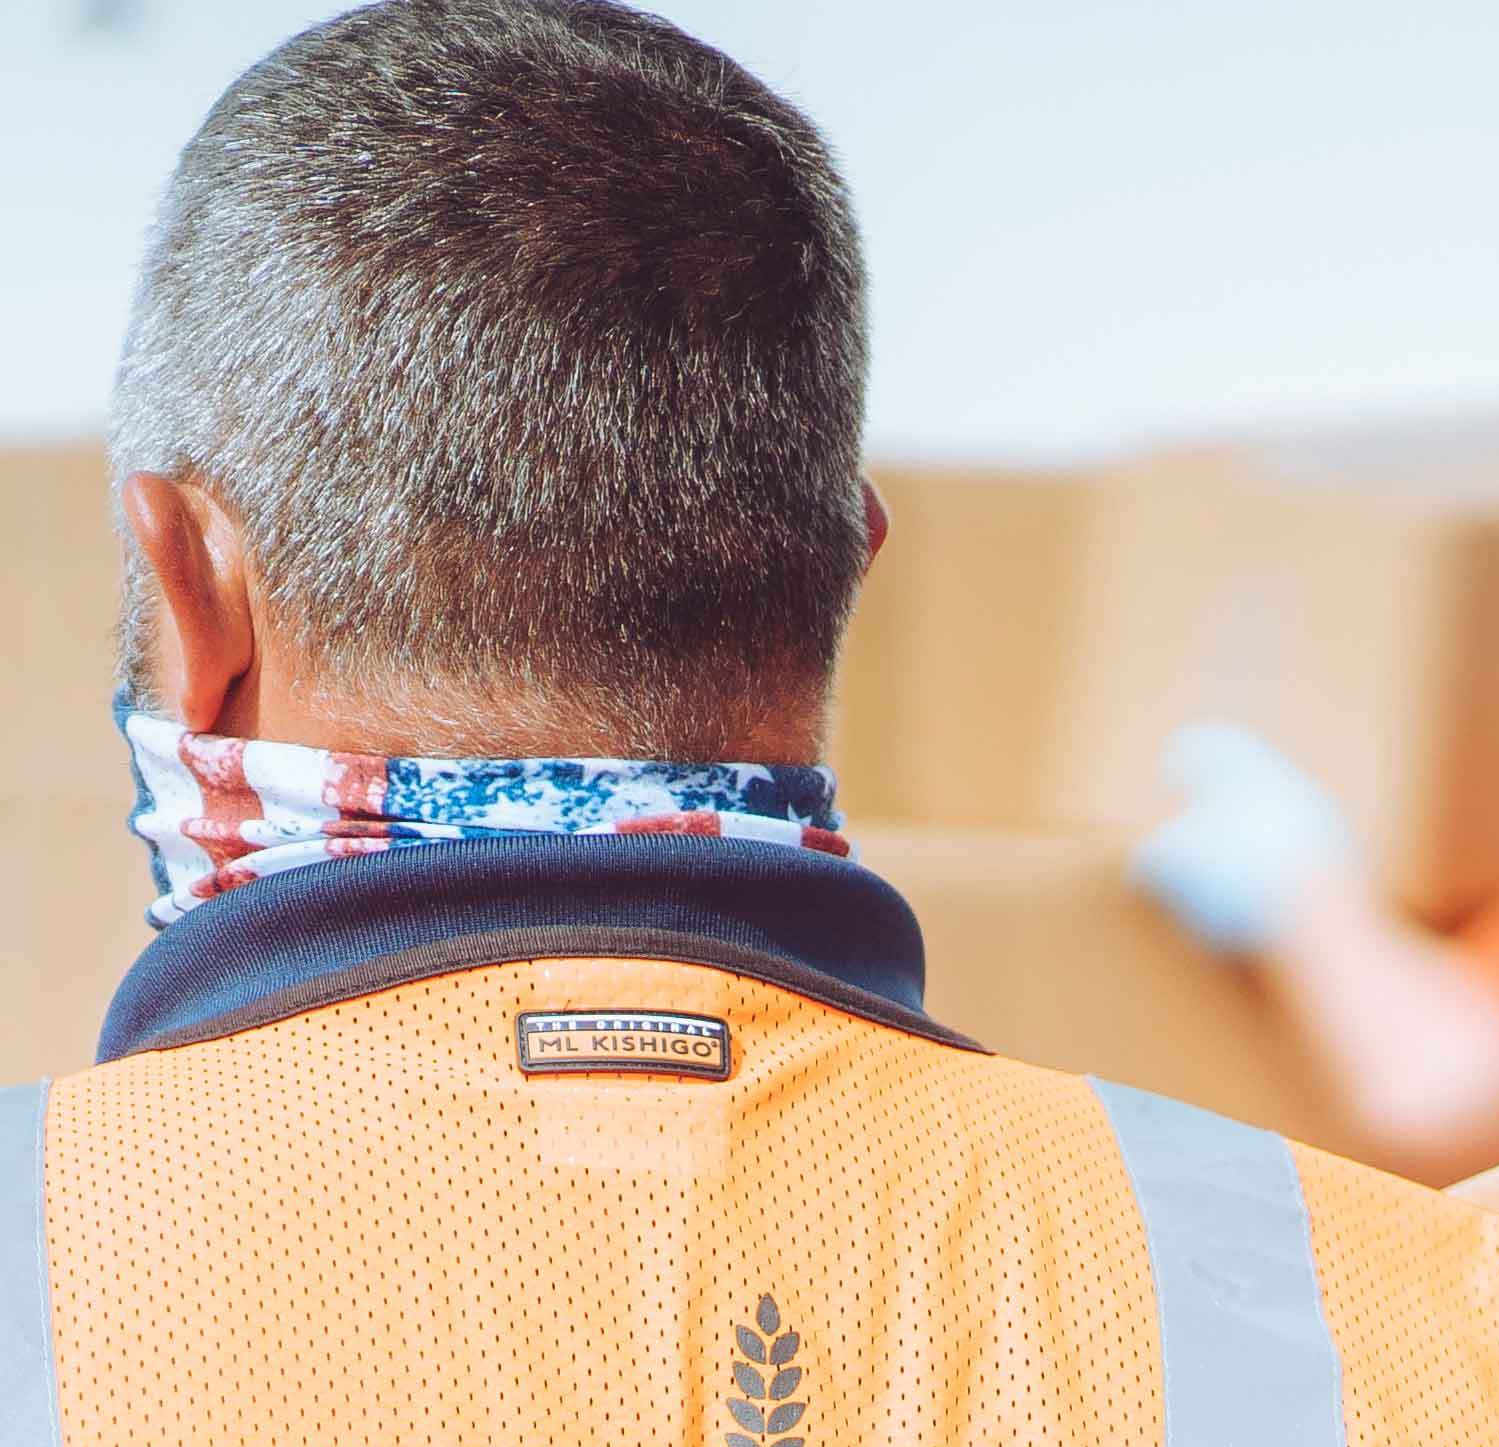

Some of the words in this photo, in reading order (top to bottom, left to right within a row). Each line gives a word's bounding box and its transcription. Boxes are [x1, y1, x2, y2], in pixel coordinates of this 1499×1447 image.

[536, 1021, 578, 1032] THE
[596, 1020, 711, 1036] ORIGINAL
[538, 1035, 579, 1053] ML
